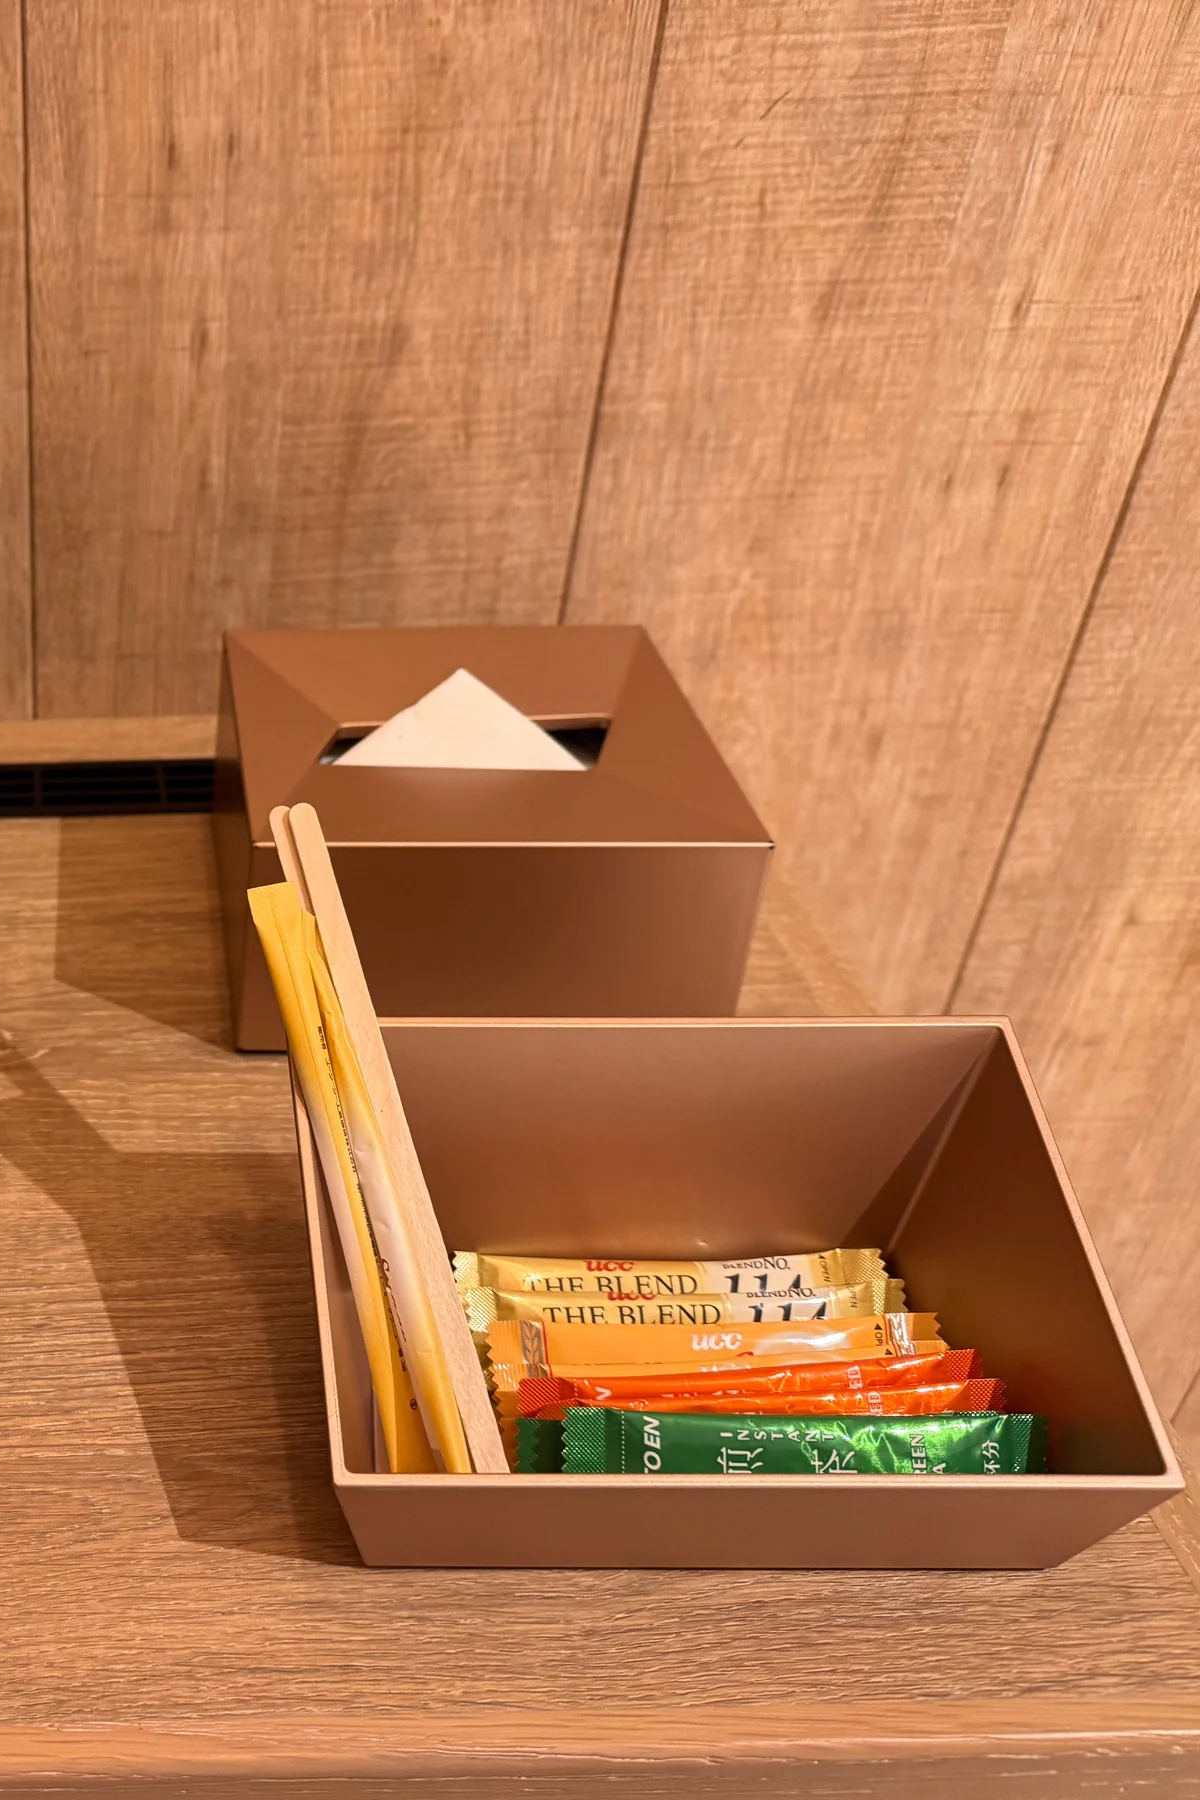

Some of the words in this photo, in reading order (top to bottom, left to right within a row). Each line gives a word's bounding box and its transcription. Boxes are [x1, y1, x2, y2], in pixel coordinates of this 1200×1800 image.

[820, 1261, 831, 1282] OPEN
[597, 1275, 697, 1295] BLEND
[543, 1306, 607, 1325] THE
[618, 1304, 721, 1325] BLEND
[720, 1429, 835, 1443] INSTANT
